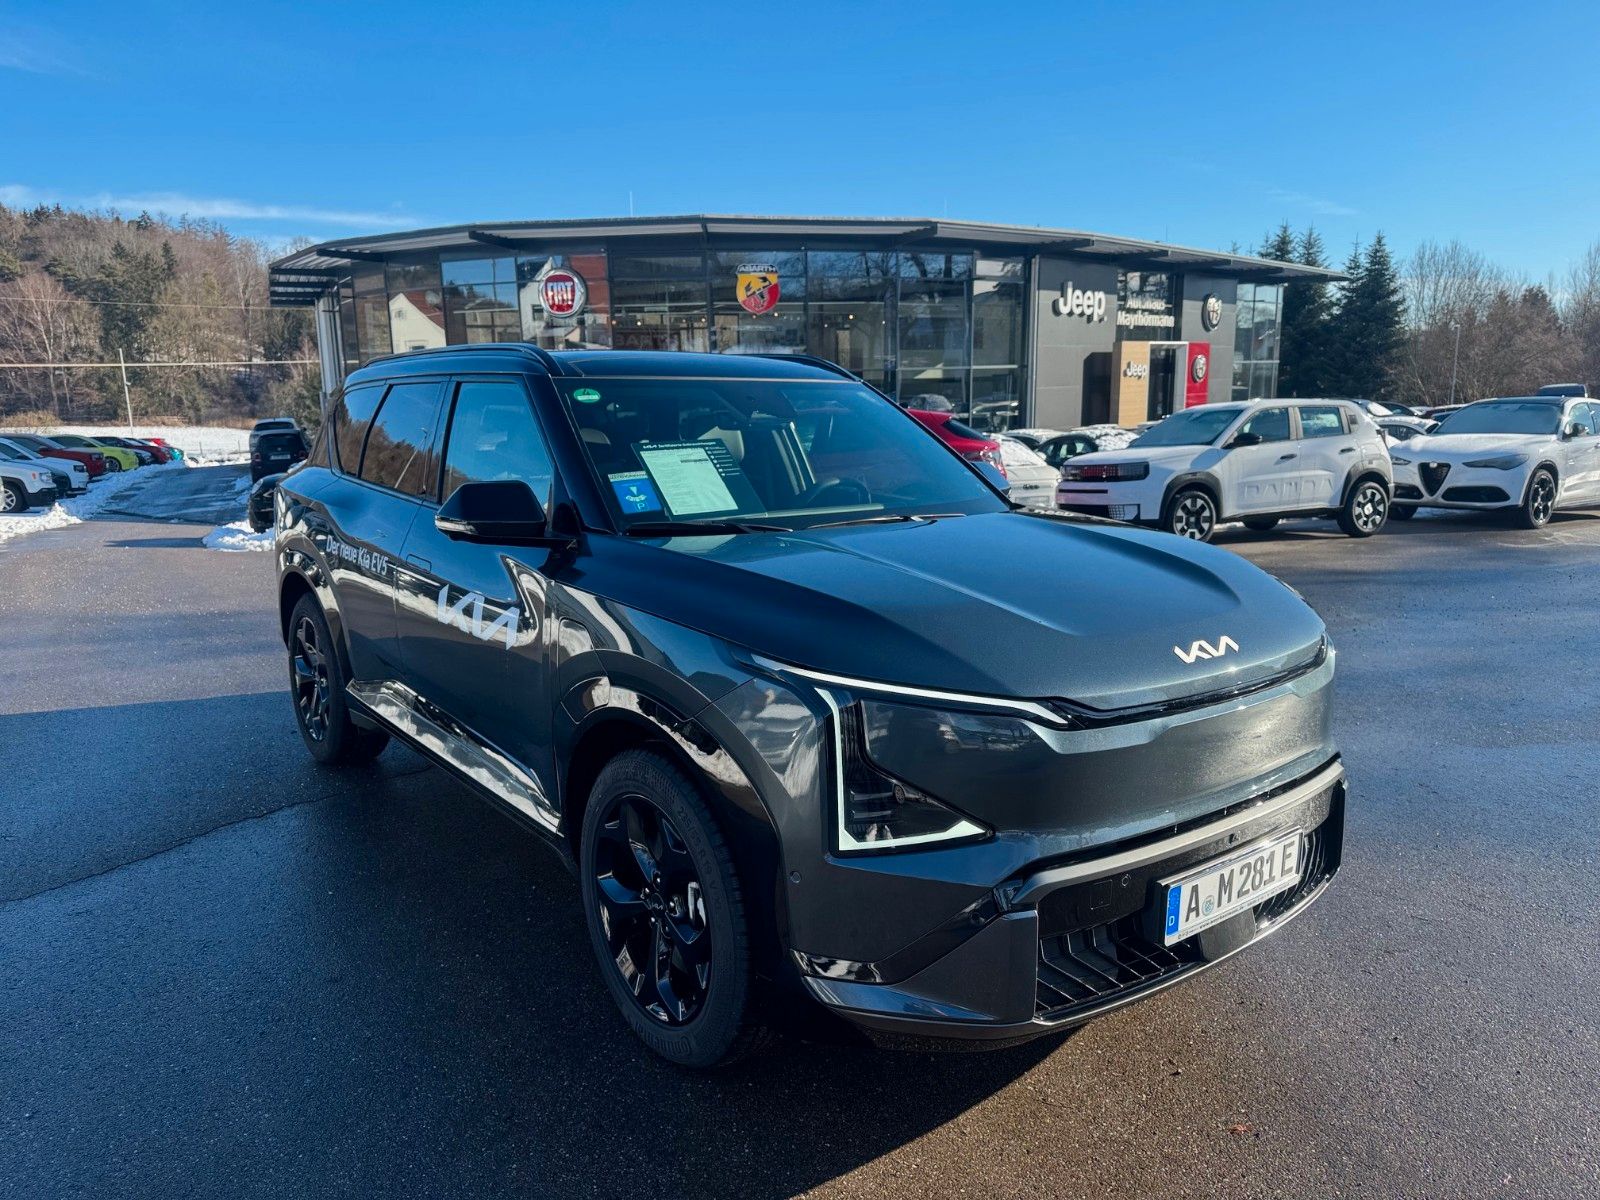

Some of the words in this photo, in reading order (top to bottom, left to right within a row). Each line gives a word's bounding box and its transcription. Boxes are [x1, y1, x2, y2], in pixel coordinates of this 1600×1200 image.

[547, 281, 574, 305] FIAT
[1058, 281, 1106, 322] Jeep
[1126, 361, 1148, 379] Jeep
[326, 534, 340, 555] Der
[340, 543, 357, 563] neue
[357, 547, 371, 569] Kia
[371, 551, 389, 576] EV5
[437, 583, 520, 651] KIA
[1173, 635, 1240, 665] KIA
[1168, 915, 1176, 927] D
[1185, 884, 1200, 922] A
